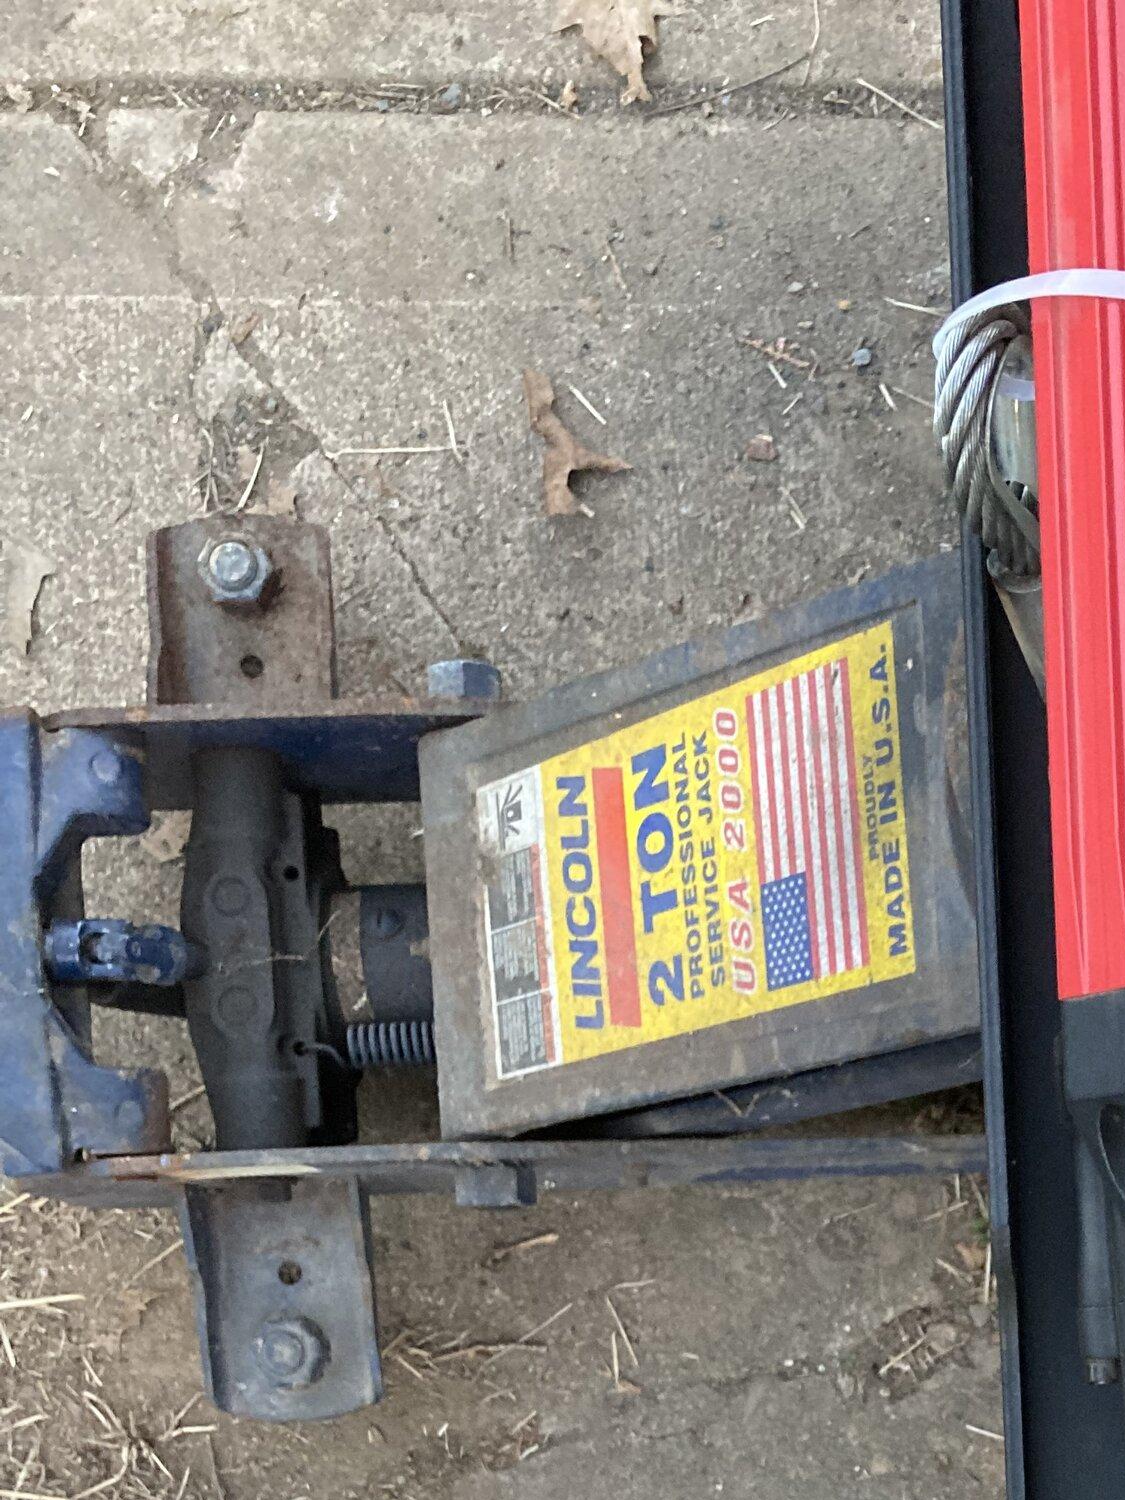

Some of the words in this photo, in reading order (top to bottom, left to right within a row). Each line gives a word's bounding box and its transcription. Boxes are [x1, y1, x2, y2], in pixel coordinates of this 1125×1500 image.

[869, 644, 895, 767] U.S.A.
[692, 730, 713, 823] JACK
[714, 710, 744, 850] 2000
[863, 755, 880, 860] PROUDLY
[877, 780, 898, 826] IN
[630, 743, 678, 934] TON
[672, 732, 705, 999] PROFESSIONAL
[882, 838, 907, 956] MADE
[556, 775, 604, 1029] LINCOLN
[701, 836, 726, 987] SERVICE
[728, 878, 757, 994] USA
[648, 954, 685, 1006] 2
